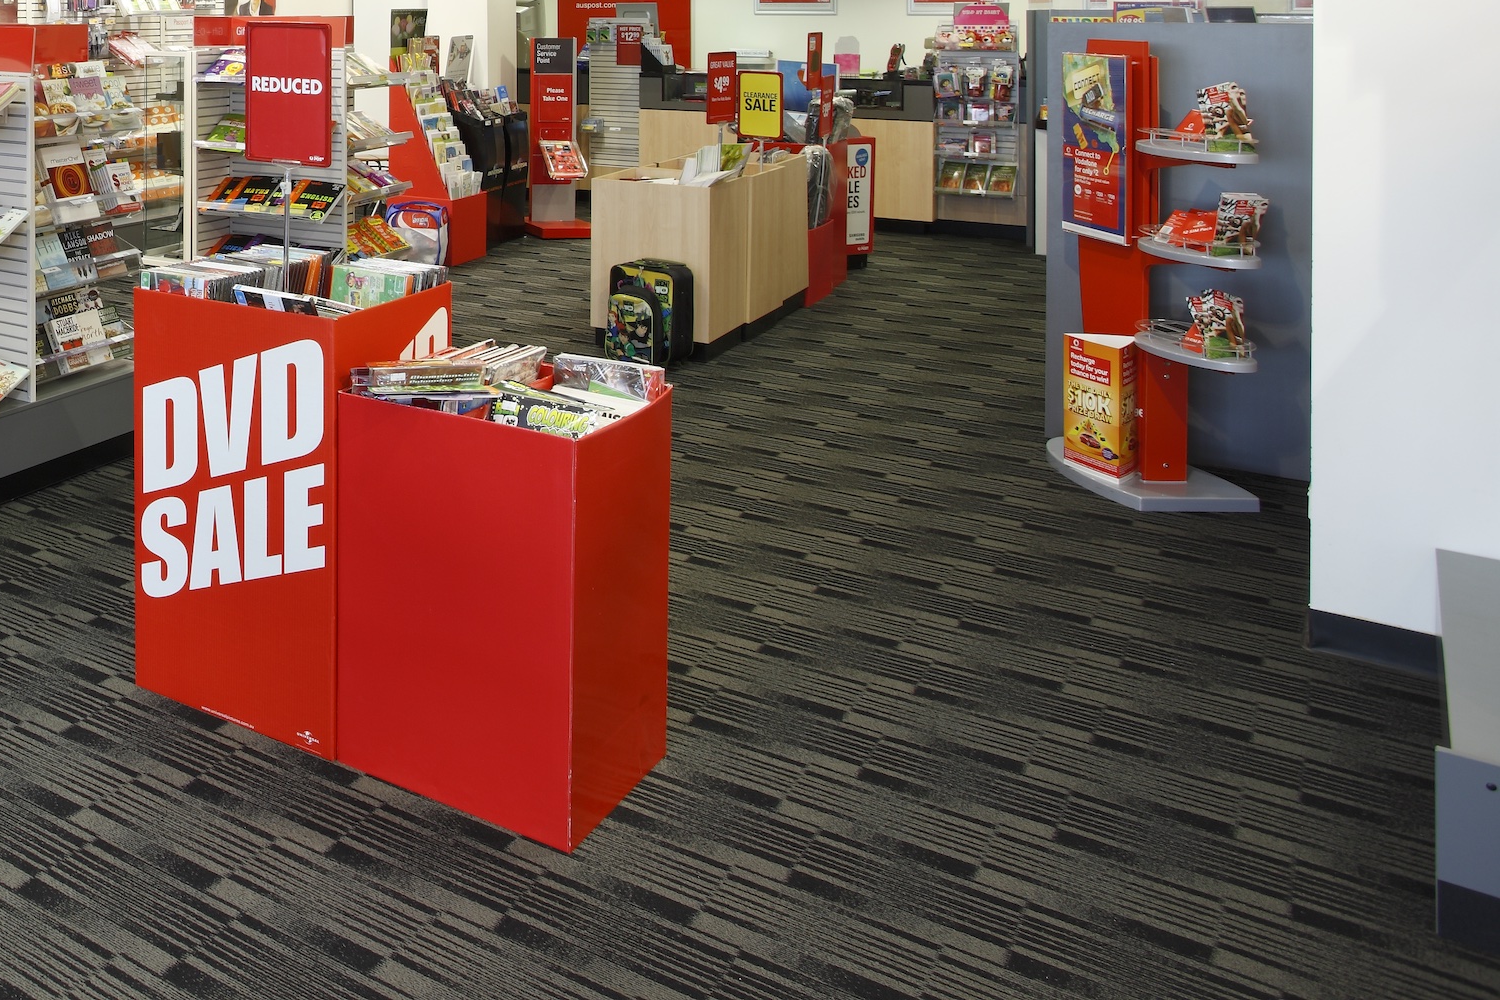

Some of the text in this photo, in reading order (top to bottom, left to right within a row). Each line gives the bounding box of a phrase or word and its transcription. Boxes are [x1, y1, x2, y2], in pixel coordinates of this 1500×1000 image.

[710, 60, 735, 69] GREAT VALUE
[251, 75, 323, 95] REDUCED
[1073, 73, 1100, 91] CONNECT
[743, 91, 778, 100] CLEARANCE
[745, 98, 777, 112] SALE
[1081, 106, 1115, 122] RECHARGE
[1075, 149, 1094, 159] Connect
[1074, 157, 1097, 167] Vodafone
[1074, 165, 1082, 173] for
[1082, 167, 1093, 176] only
[87, 230, 114, 243] SHADOW
[53, 301, 79, 316] DOBBS
[56, 317, 74, 327] STUART
[1070, 352, 1095, 365] Recharge
[1070, 360, 1108, 376] today for your
[1070, 368, 1089, 378] chance
[1067, 388, 1111, 416] $10K
[1067, 403, 1089, 416] PRIZE
[142, 339, 325, 494] DVD
[527, 404, 590, 434] COLOURING
[141, 463, 325, 599] SALE
